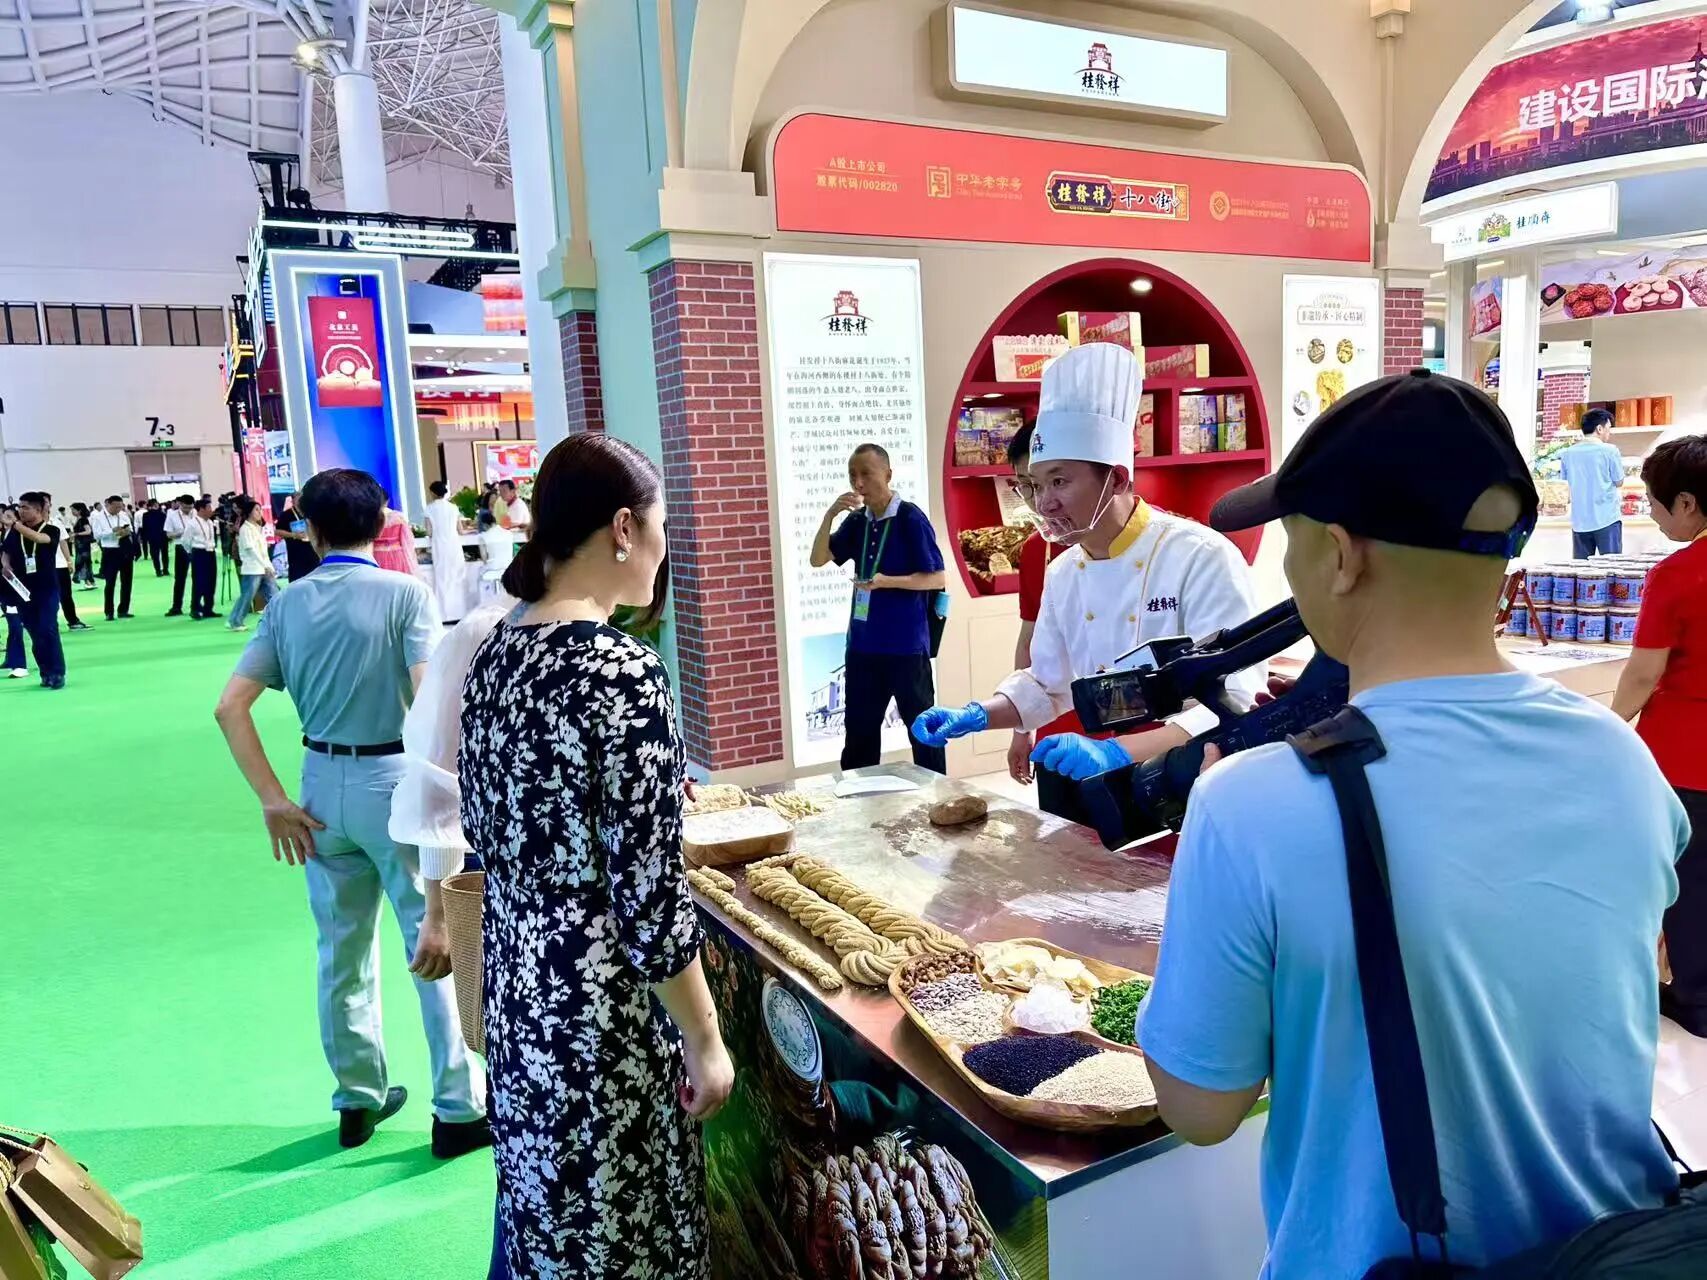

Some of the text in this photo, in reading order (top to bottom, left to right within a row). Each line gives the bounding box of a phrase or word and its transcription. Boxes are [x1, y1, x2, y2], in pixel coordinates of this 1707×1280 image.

[829, 157, 886, 174] A股上市公司
[816, 175, 898, 192] 股票代码/002820
[956, 173, 1023, 192] 中华老字号
[1120, 187, 1171, 213] 十八街
[145, 416, 175, 436] 7-3
